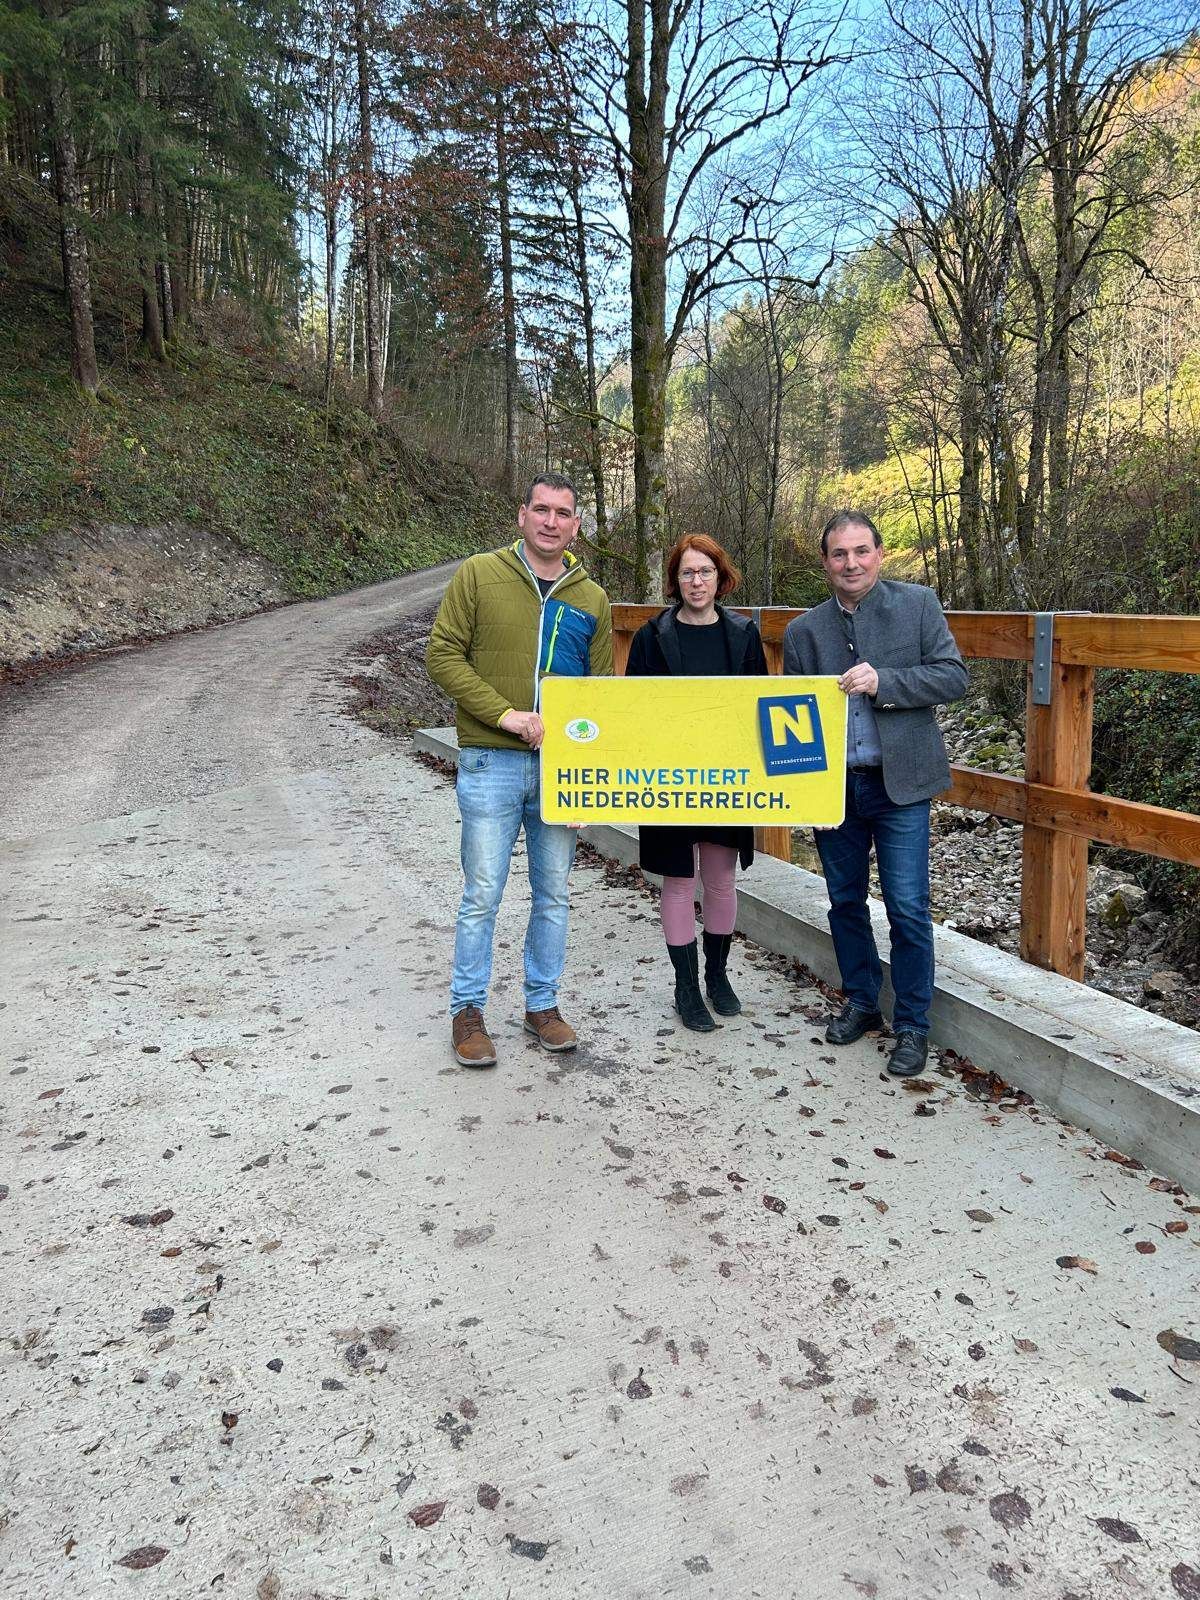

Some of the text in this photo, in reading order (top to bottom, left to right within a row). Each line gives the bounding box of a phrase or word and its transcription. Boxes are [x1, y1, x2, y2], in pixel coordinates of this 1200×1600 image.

[768, 704, 815, 746] N
[557, 768, 750, 785] HIER INVESTIERT
[557, 787, 791, 809] NIEDERÖSTERREICH.
